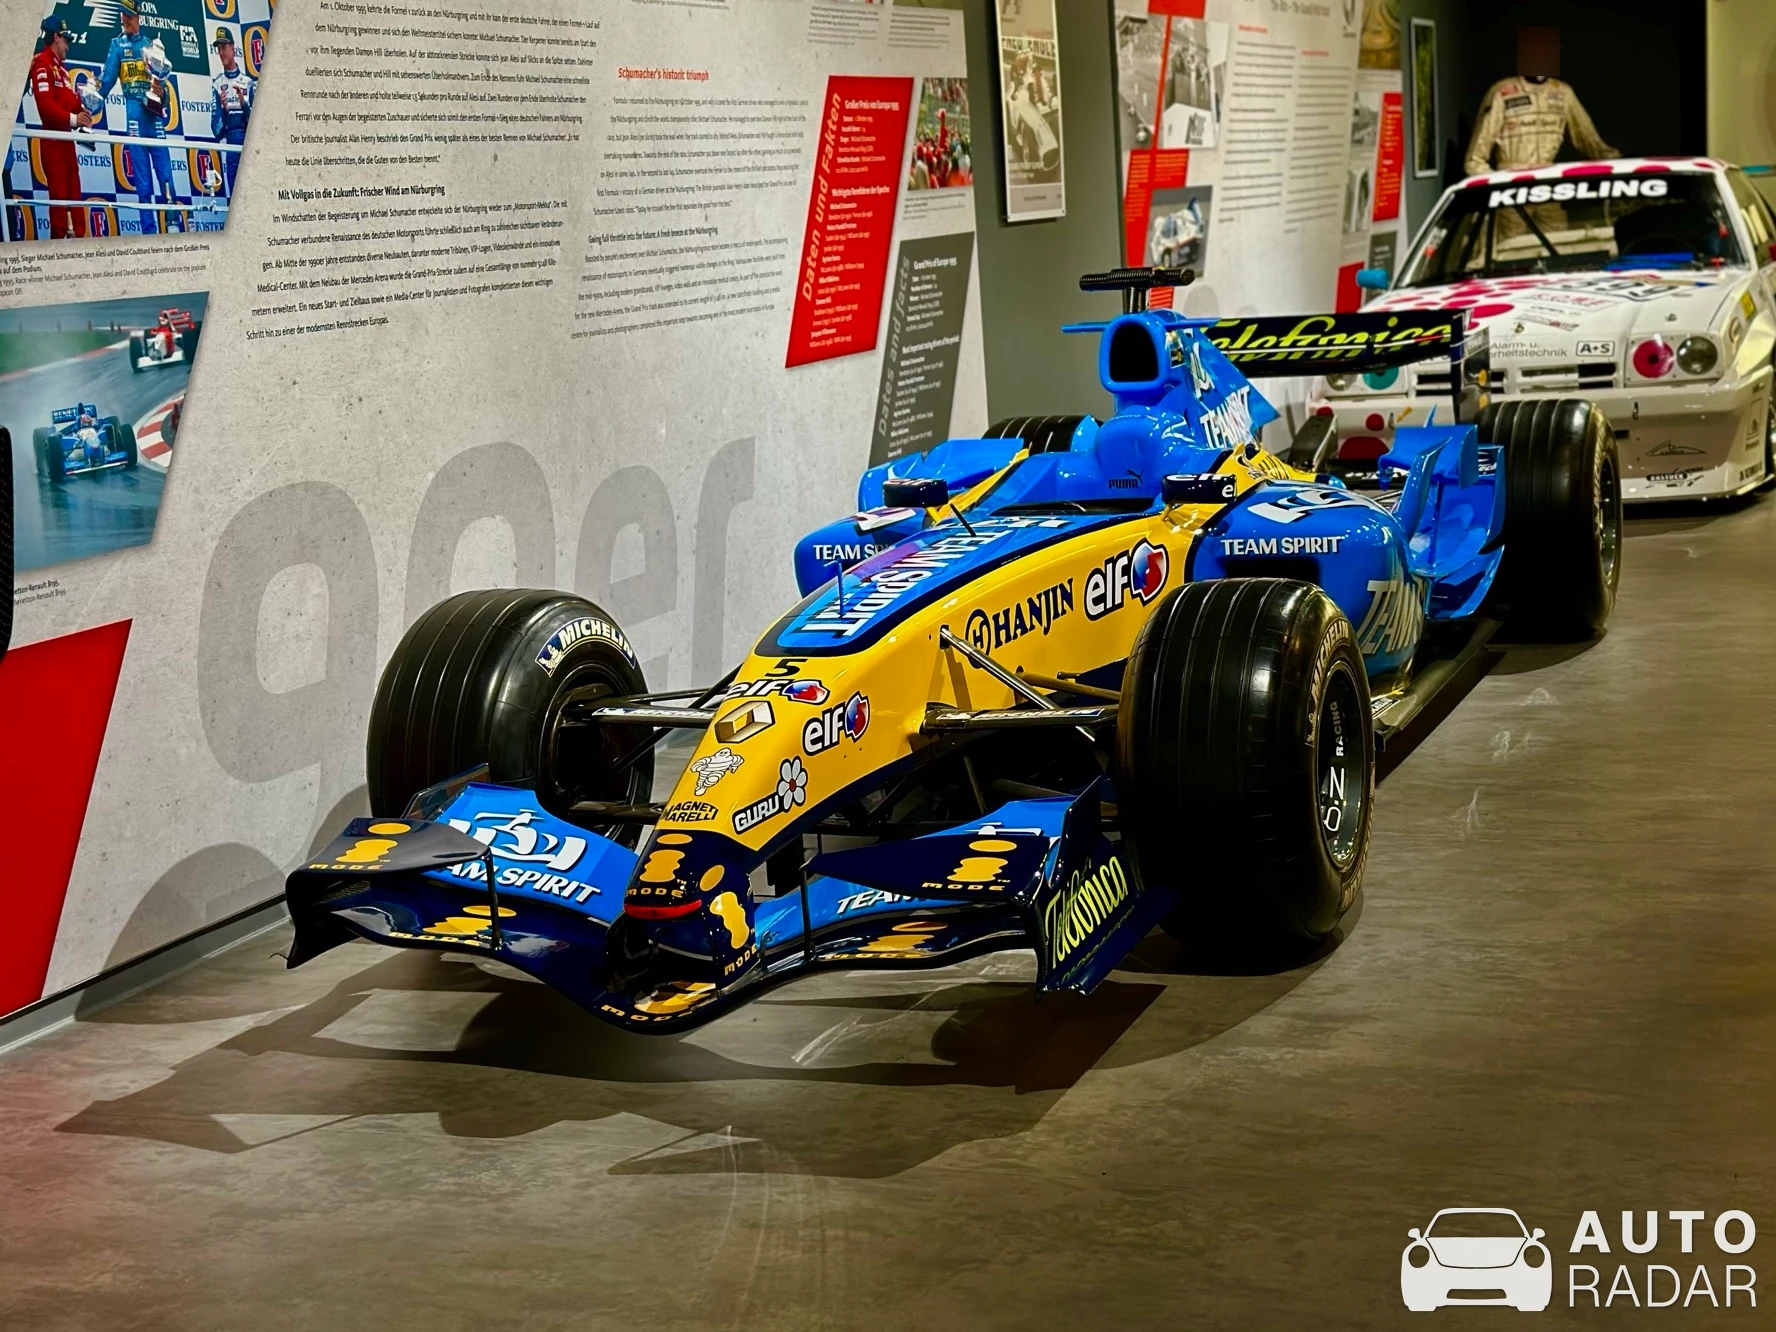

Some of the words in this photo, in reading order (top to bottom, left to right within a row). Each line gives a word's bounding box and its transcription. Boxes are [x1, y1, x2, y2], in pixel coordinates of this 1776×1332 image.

[618, 66, 661, 80] Schumacher's
[662, 68, 685, 81] historic
[686, 69, 709, 83] triumph
[821, 92, 842, 174] Fakten
[77, 154, 112, 168] OSTER'S
[285, 156, 300, 165] heute
[300, 156, 309, 165] die
[278, 188, 290, 199] Mit
[290, 188, 314, 202] Vollgas
[314, 187, 321, 198] in
[322, 187, 332, 198] die
[332, 186, 359, 198] Zukunft:
[360, 186, 384, 197] Frischer
[384, 186, 400, 197] Wind
[400, 187, 410, 196] am
[410, 184, 445, 199] Nürburgring
[814, 174, 829, 224] und
[1488, 179, 1668, 208] KISSLING
[281, 211, 316, 222] Windschatten
[317, 210, 326, 220] der
[327, 209, 360, 222] Begeisterung
[370, 208, 388, 218] Michael
[389, 206, 416, 217] Schumacher
[267, 234, 300, 246] Schumacher
[300, 233, 330, 244] verbundene
[332, 231, 360, 242] Renaissance
[362, 230, 370, 240] des
[371, 229, 395, 240] deutschen
[588, 235, 602, 245] Going
[283, 257, 297, 267] Mitte
[298, 257, 307, 266] der
[802, 229, 821, 302] Daten
[895, 255, 910, 318] facts
[246, 328, 264, 340] Schritt
[282, 325, 295, 336] einer
[296, 324, 304, 335] der
[890, 315, 902, 363] and
[1490, 342, 1528, 350] Alarm-
[1580, 343, 1610, 354] A+S
[878, 367, 895, 437] Dates
[813, 544, 861, 561] TEAM
[1221, 537, 1278, 556] TEAM
[1281, 536, 1345, 555] SPIRIT
[1085, 554, 1129, 616] elf
[992, 577, 1074, 649] HANJIN
[558, 619, 634, 659] MICHELIN
[764, 659, 809, 677] 5
[724, 680, 791, 697] elf
[804, 706, 844, 753] elf
[734, 794, 780, 832] GURU
[446, 859, 491, 880] AM
[497, 868, 601, 903] SPIRIT
